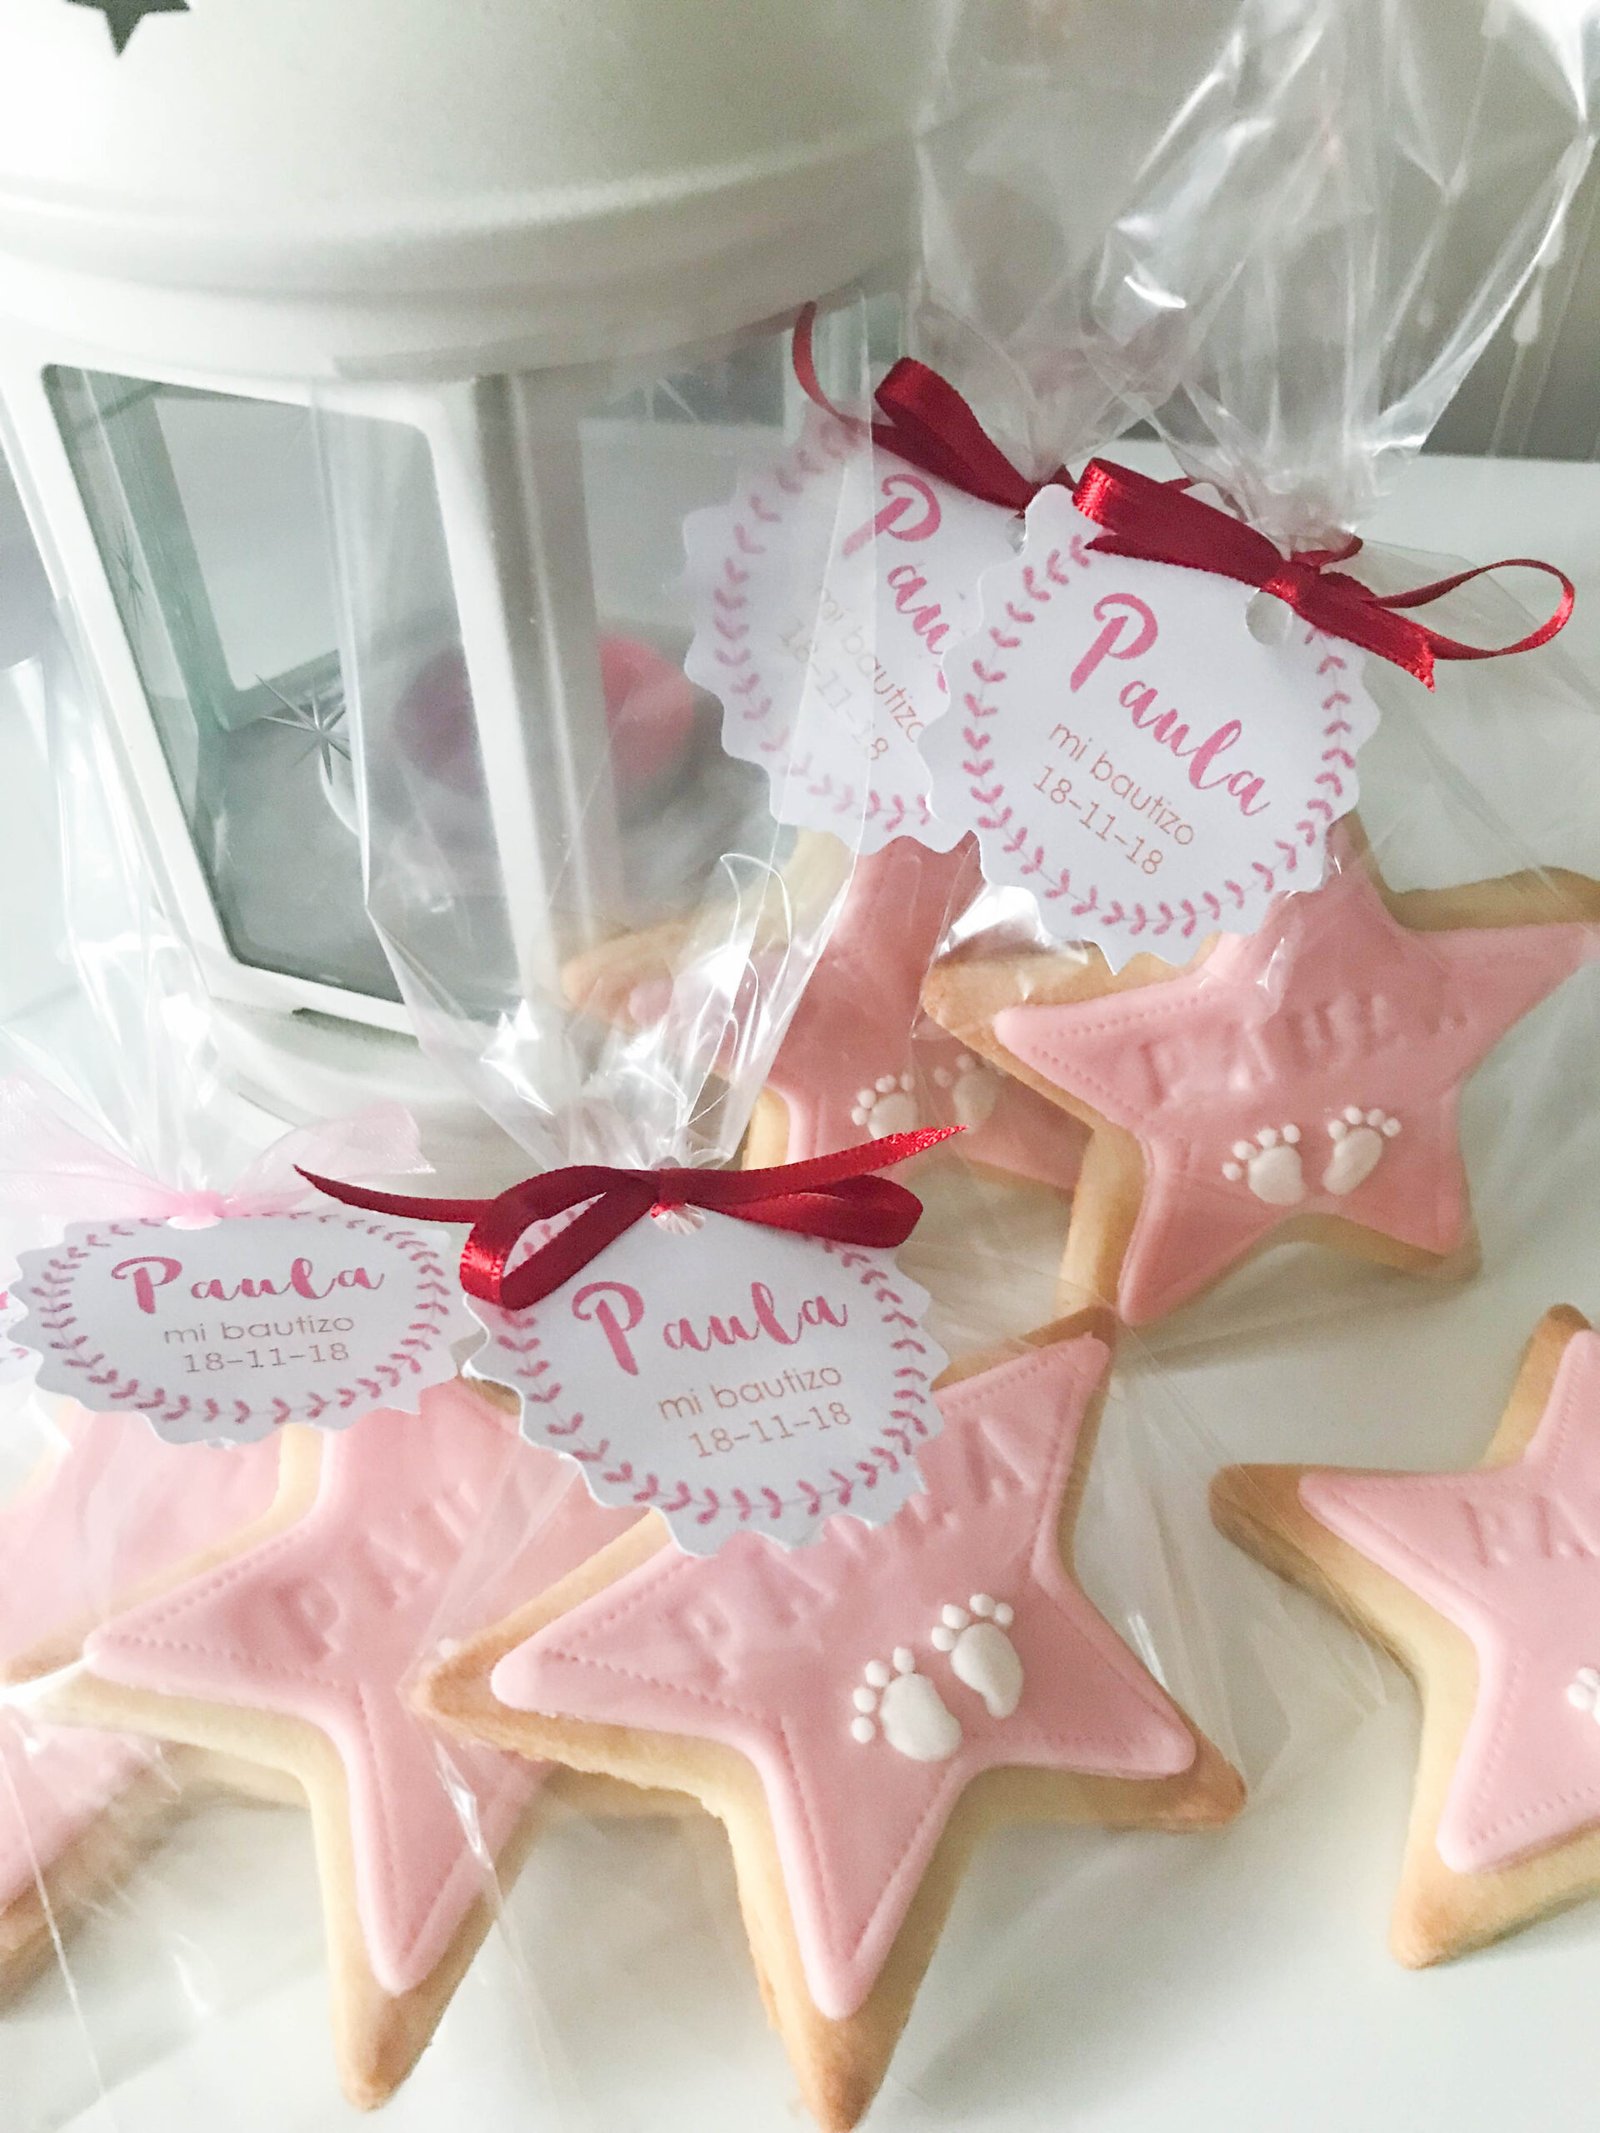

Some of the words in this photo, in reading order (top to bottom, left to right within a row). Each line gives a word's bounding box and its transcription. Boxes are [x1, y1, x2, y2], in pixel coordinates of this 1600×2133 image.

[1069, 592, 1271, 816] Paula
[1048, 723, 1093, 762] mi
[1090, 751, 1195, 847] bautizo
[1033, 766, 1165, 876] 18-11-18
[111, 1256, 385, 1314] Paula
[164, 1323, 207, 1344] mi
[222, 1315, 355, 1340] bautizo
[571, 1281, 848, 1376] Paula
[185, 1342, 350, 1374] 18-11-18
[657, 1388, 703, 1421] mi
[711, 1364, 843, 1411] bautizo
[688, 1401, 852, 1459] 18-11-18
